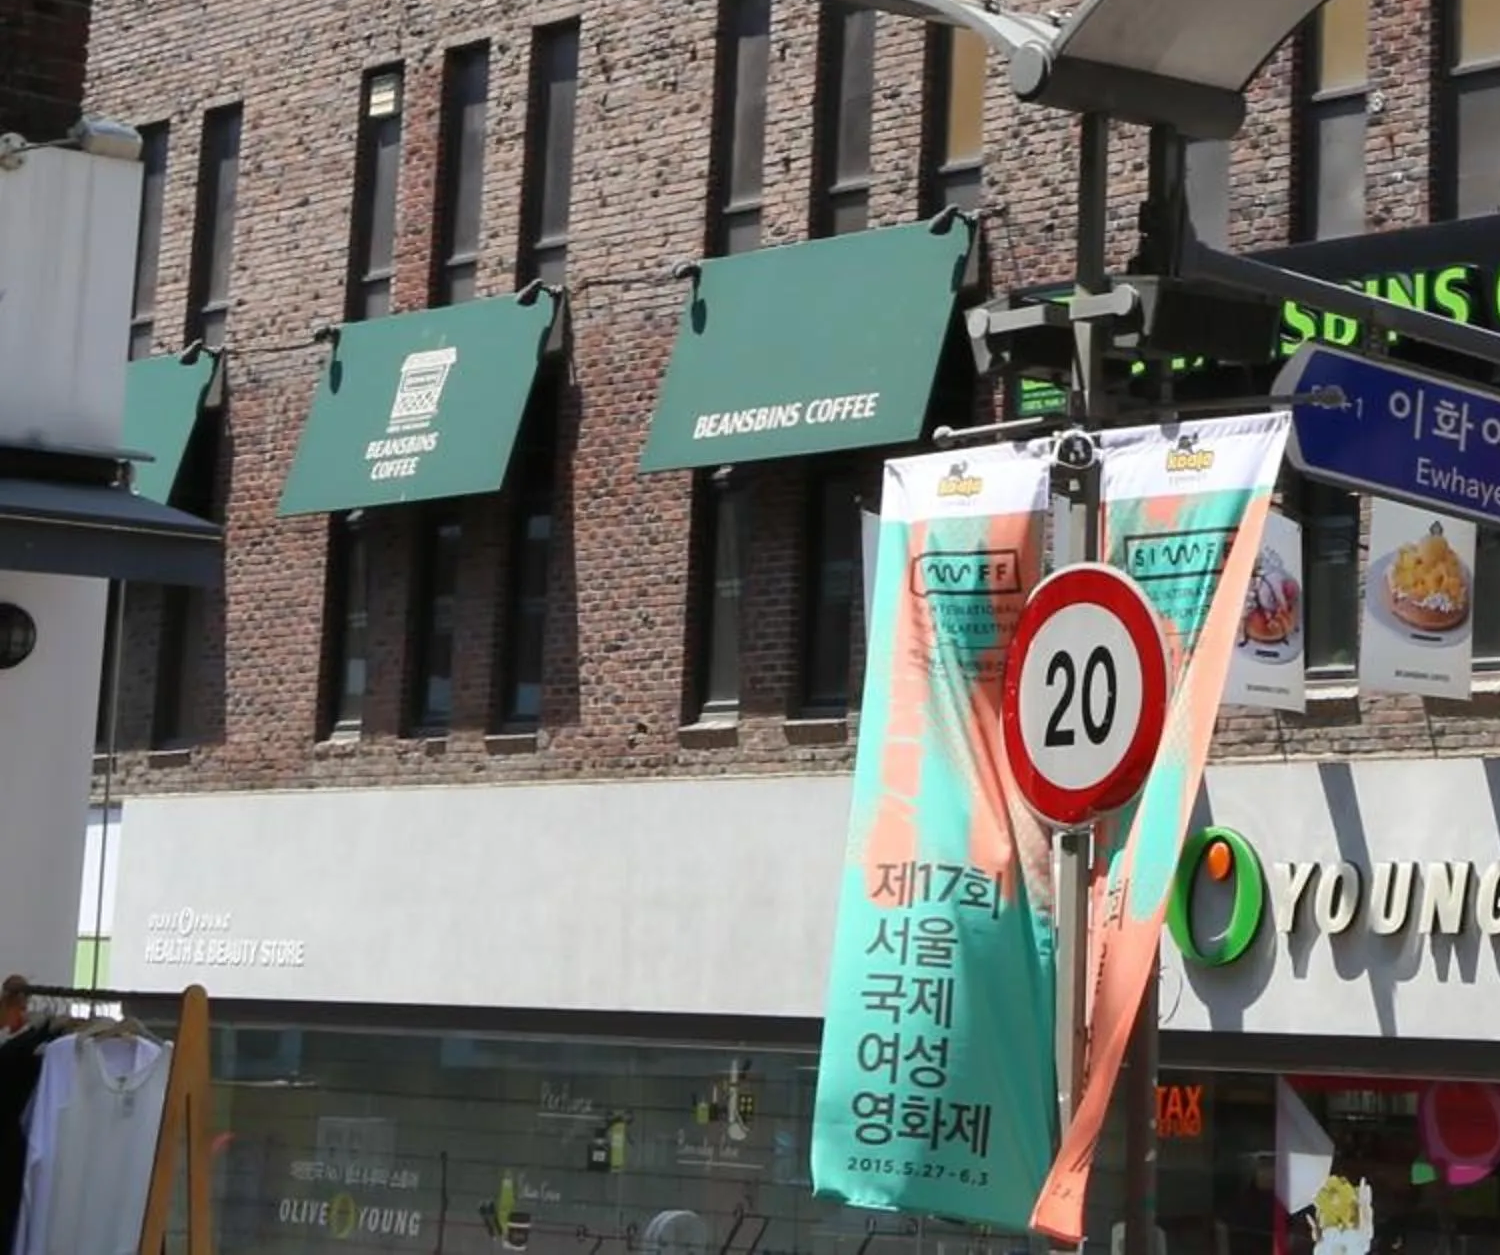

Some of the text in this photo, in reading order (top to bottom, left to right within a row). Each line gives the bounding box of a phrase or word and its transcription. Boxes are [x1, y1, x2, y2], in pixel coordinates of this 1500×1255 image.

[692, 392, 880, 440] BEANSBINS COFFEE
[365, 430, 440, 460] BEANSBINS
[370, 456, 420, 481] COFFEE
[1045, 645, 1117, 747] 20
[871, 860, 1001, 921] 제17회
[144, 938, 193, 964] HEALTH
[207, 939, 258, 967] BEAUTY
[259, 940, 306, 968] STORE
[865, 915, 959, 969] 서울
[861, 973, 955, 1030] 국제
[857, 1032, 949, 1090] 여성
[851, 1091, 992, 1158] 영화제
[1155, 1085, 1203, 1121] TAX
[278, 1196, 424, 1240] OLIVE YOUNG
